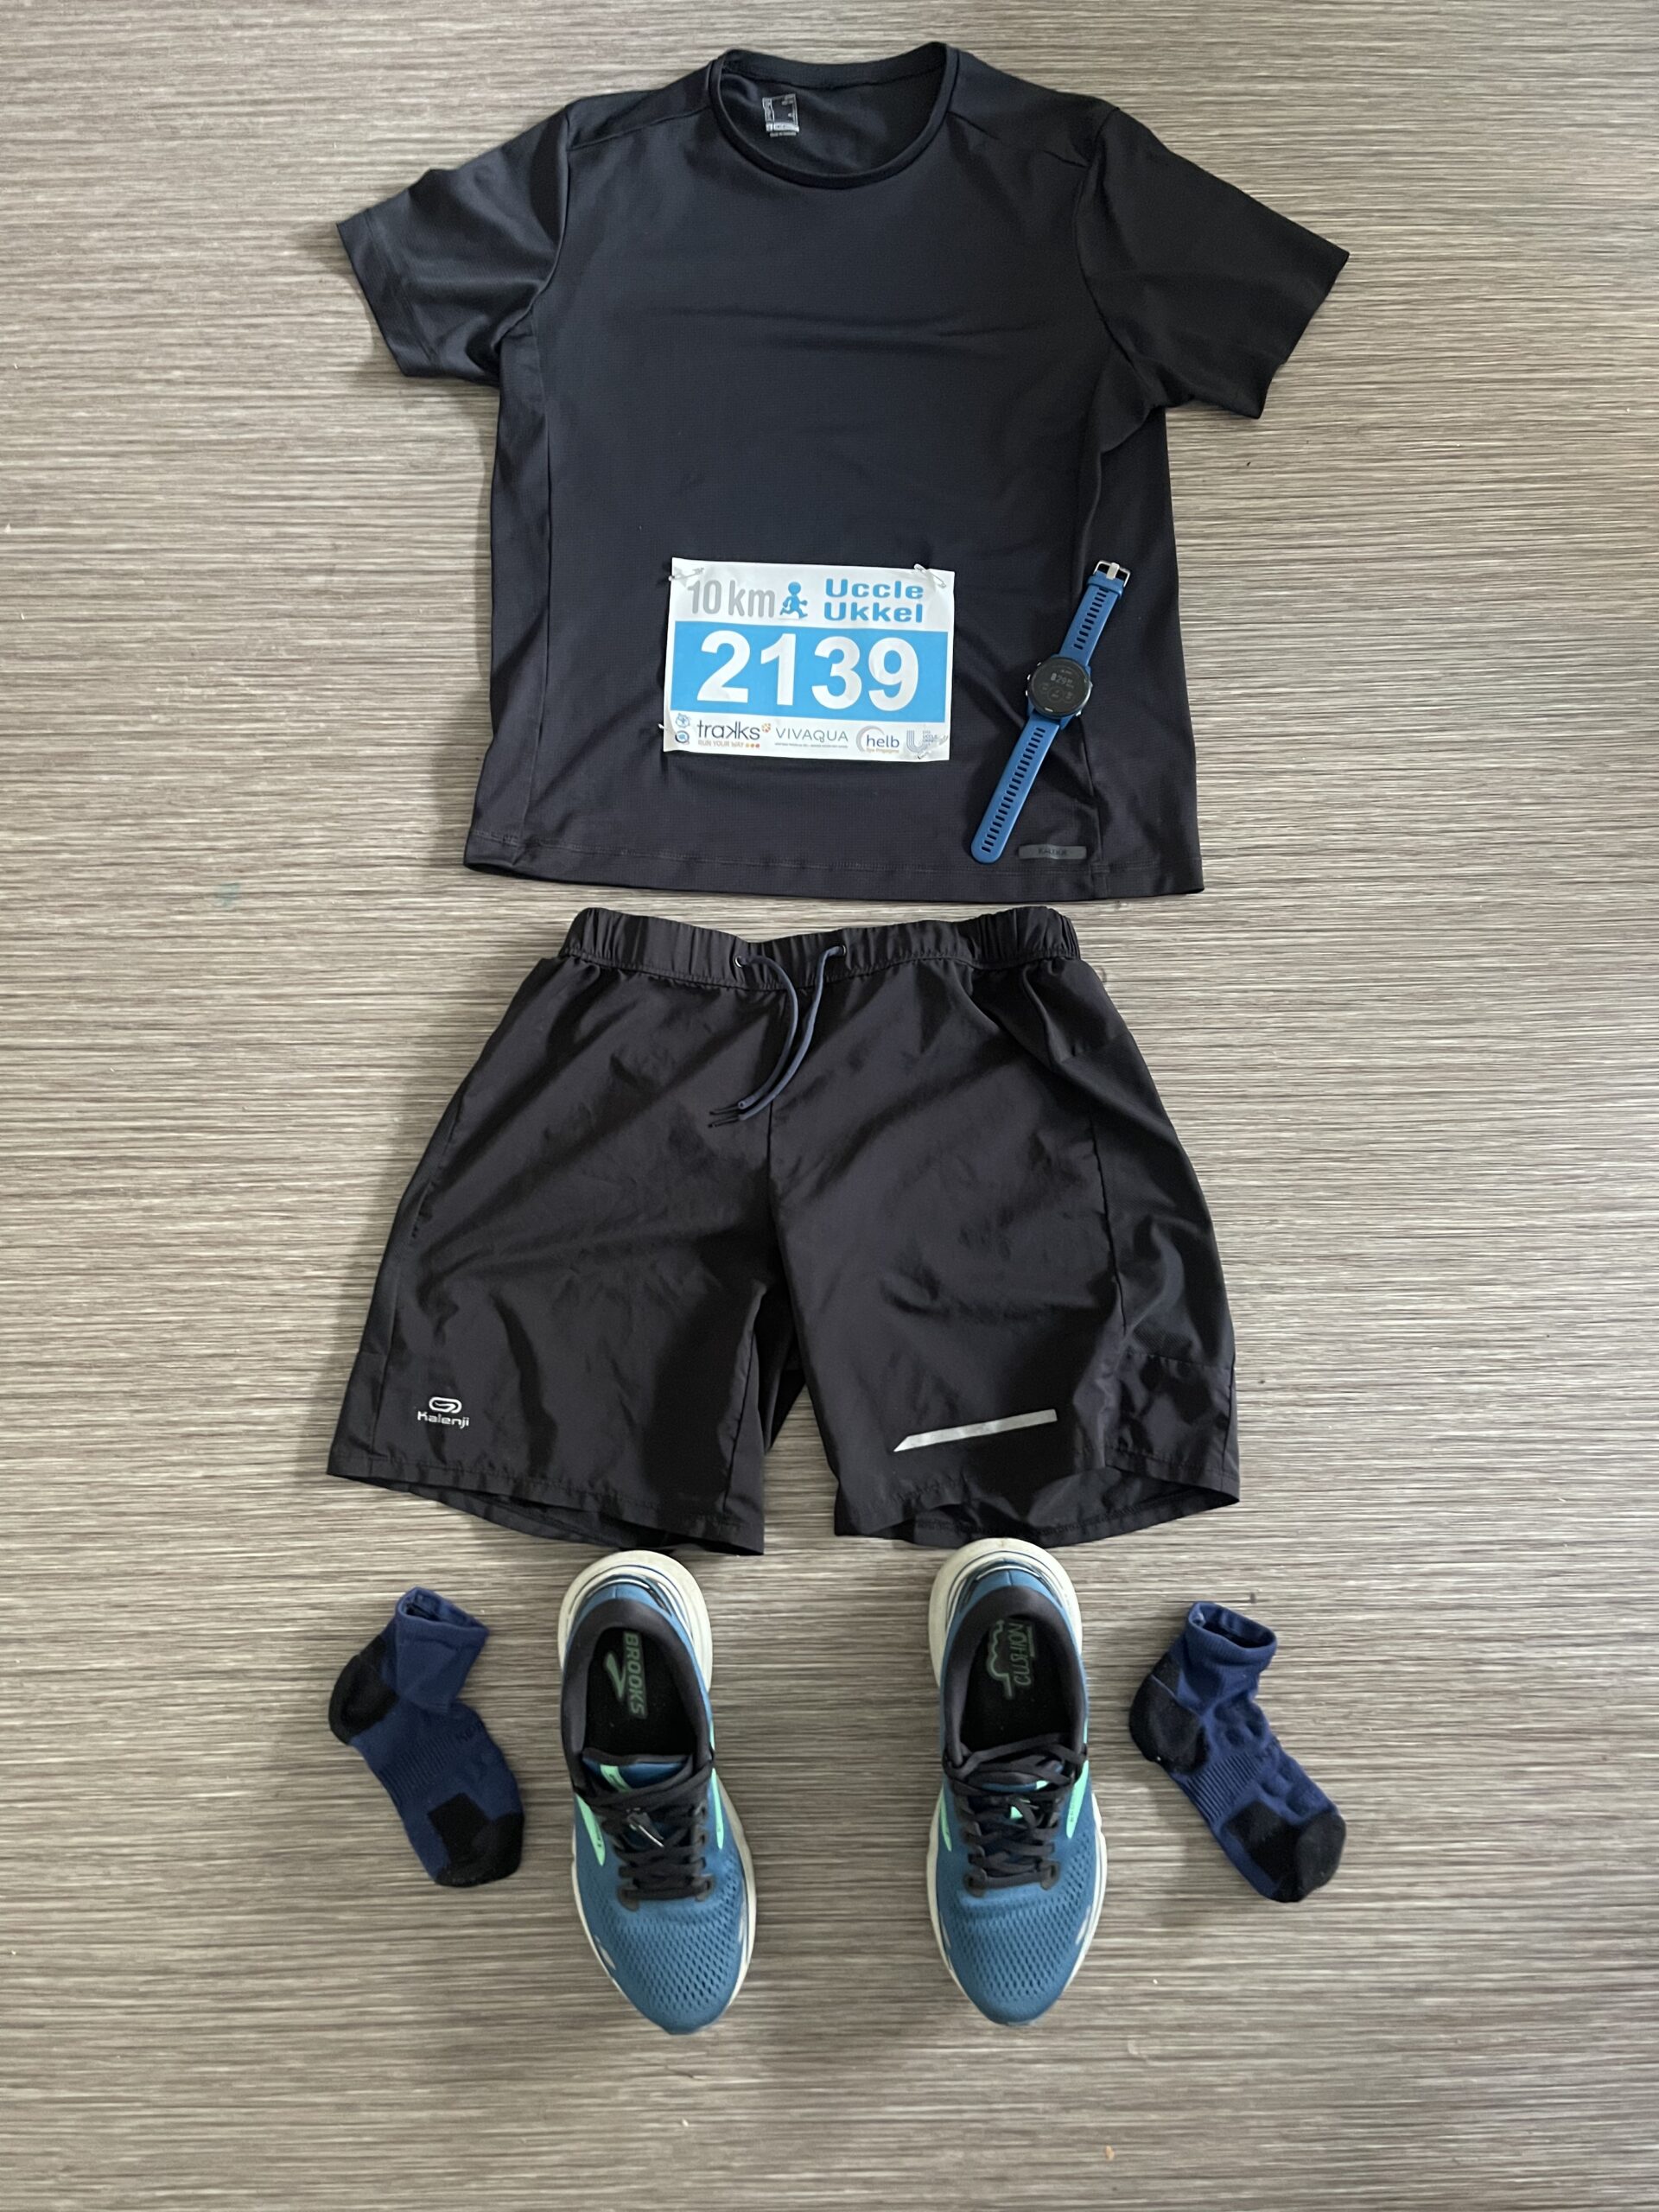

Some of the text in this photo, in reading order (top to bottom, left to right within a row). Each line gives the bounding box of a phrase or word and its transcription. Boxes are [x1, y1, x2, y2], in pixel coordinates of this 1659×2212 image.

[825, 578, 924, 599] Uccle
[687, 580, 776, 619] 10 km
[823, 602, 923, 623] Ukkel
[696, 630, 919, 712] 2139
[696, 720, 760, 741] trakks
[776, 728, 849, 743] VIVAQUA
[867, 734, 900, 748] helb
[417, 1410, 470, 1429] Kalenji
[1007, 1623, 1031, 1685] CUSHION
[625, 1632, 645, 1715] BROOKS
